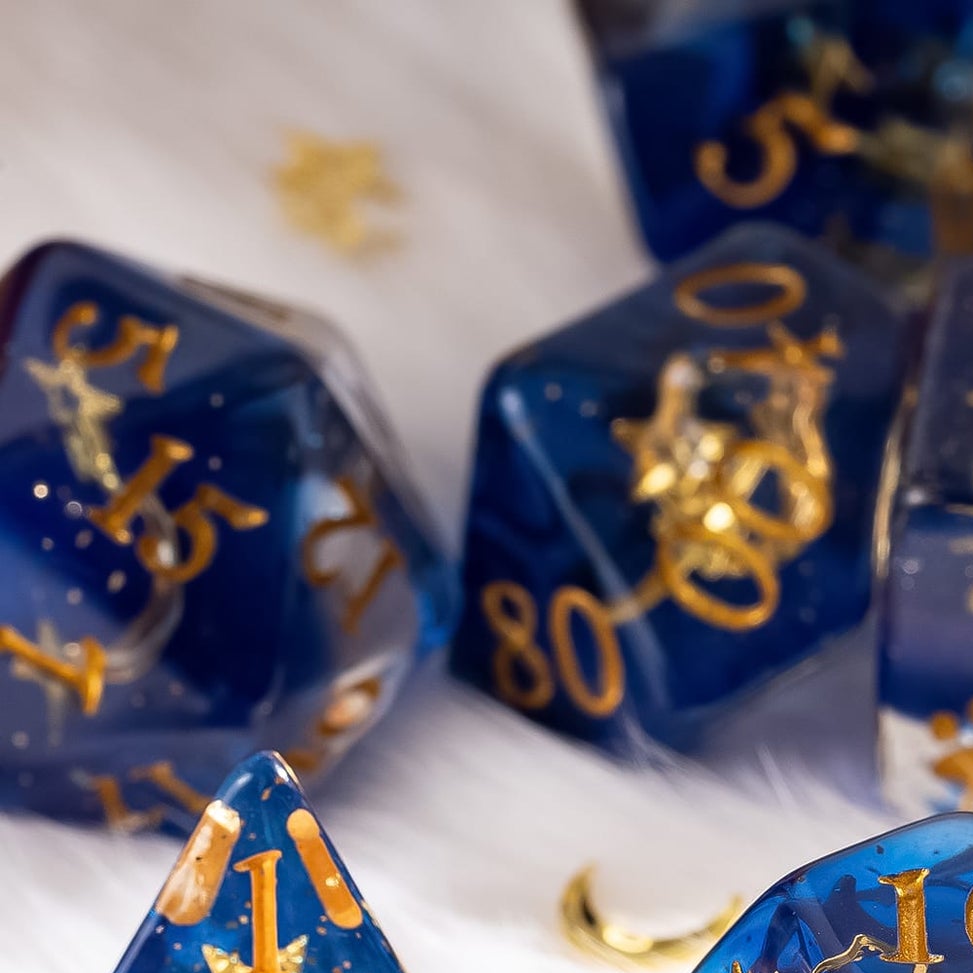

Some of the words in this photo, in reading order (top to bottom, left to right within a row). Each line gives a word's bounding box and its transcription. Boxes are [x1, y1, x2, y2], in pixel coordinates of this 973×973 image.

[53, 302, 179, 393] 5
[89, 433, 269, 583] 15
[481, 581, 624, 717] 80
